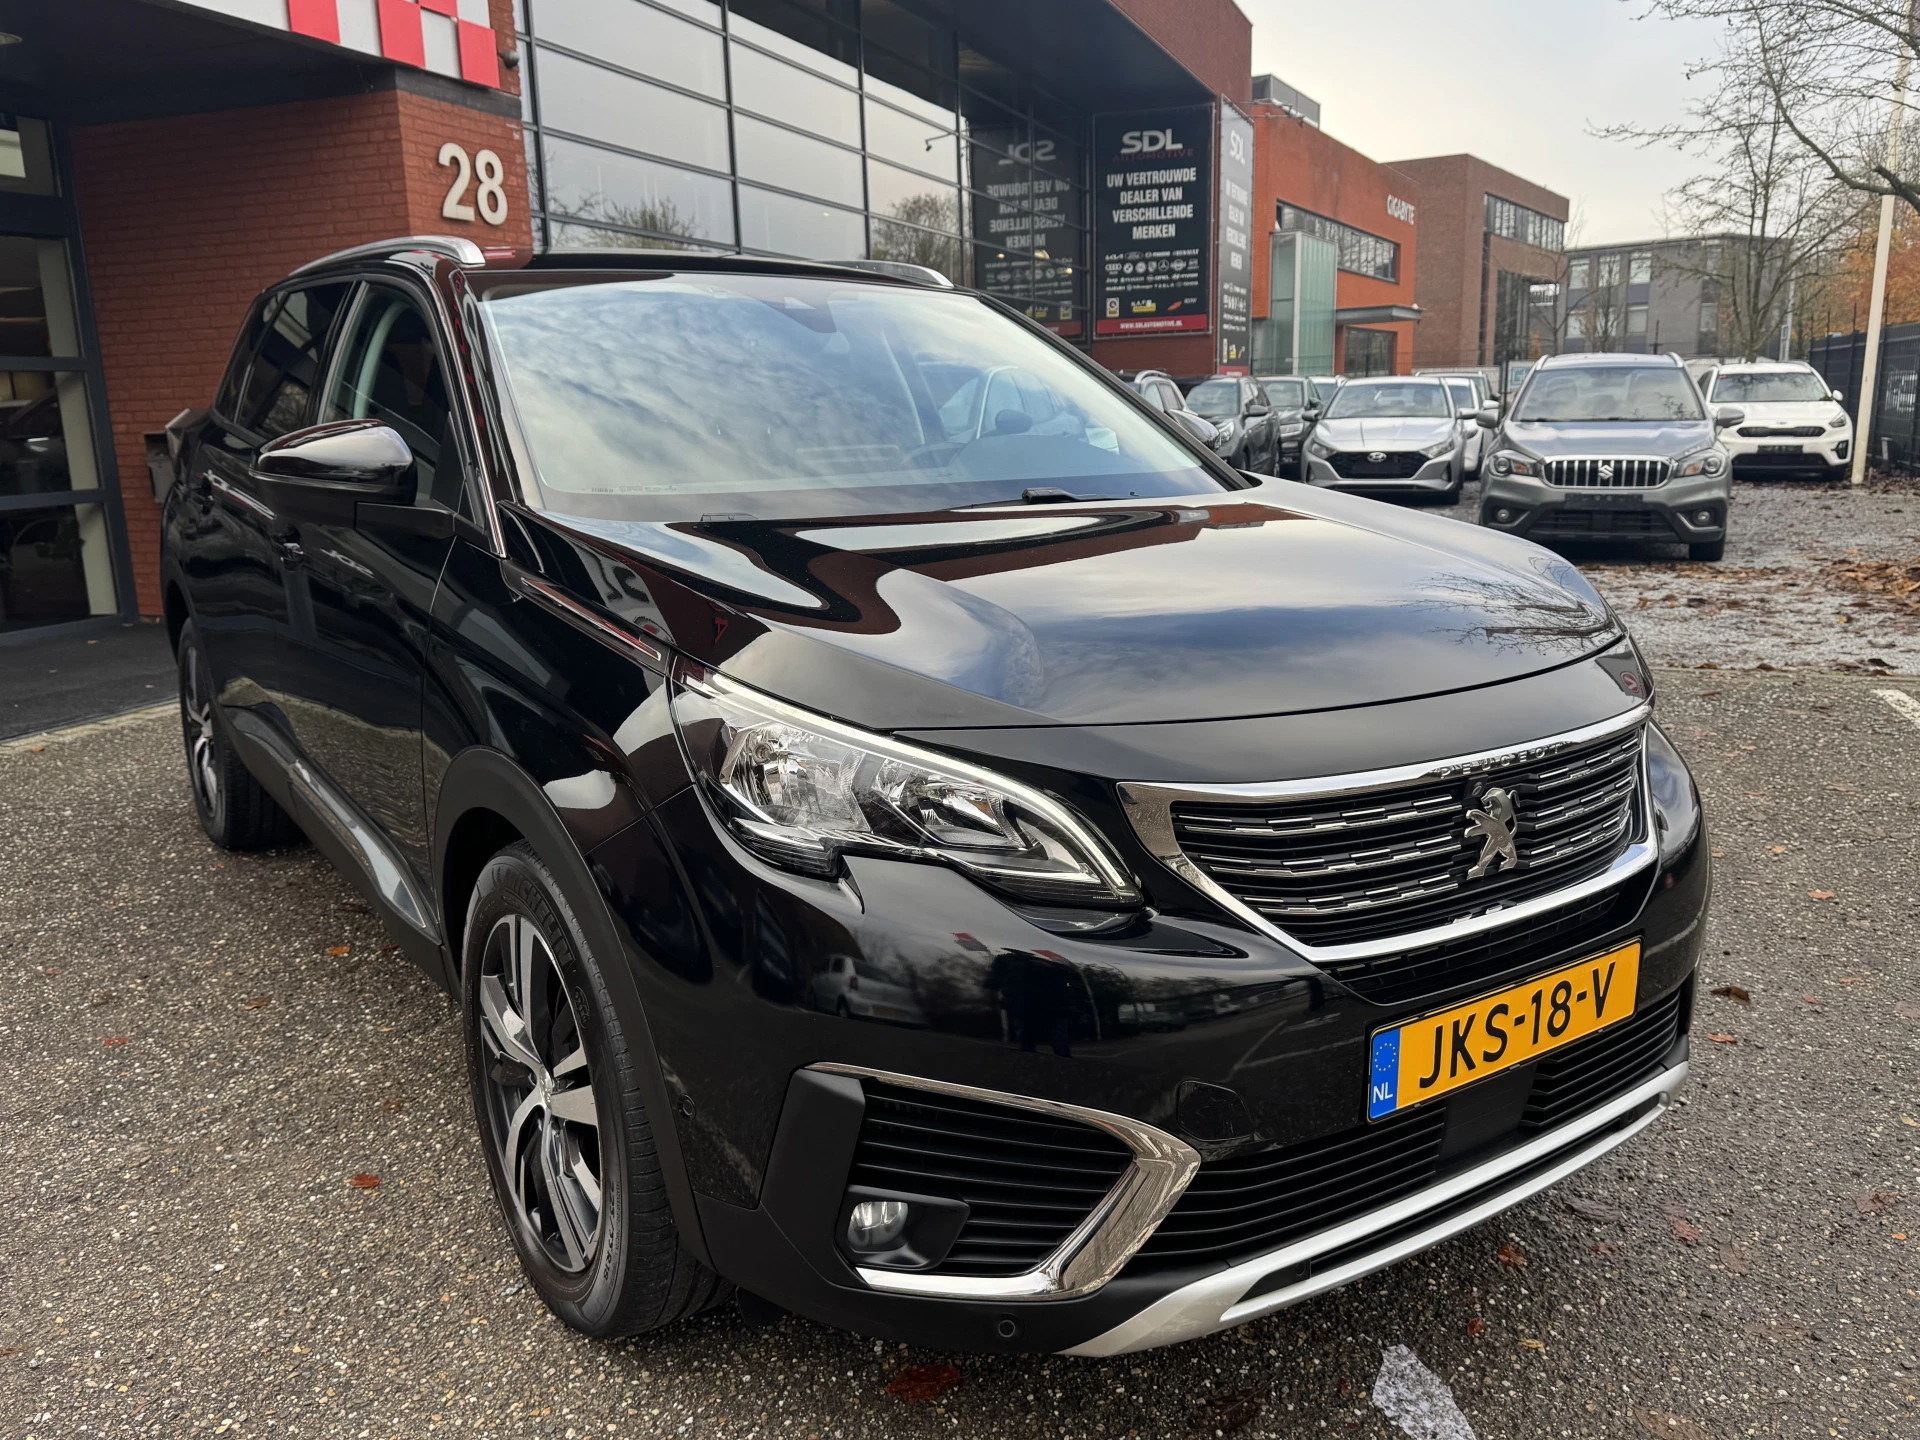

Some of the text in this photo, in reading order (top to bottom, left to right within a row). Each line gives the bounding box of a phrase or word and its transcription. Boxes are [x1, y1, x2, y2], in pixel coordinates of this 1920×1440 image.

[1120, 129, 1183, 154] SDL
[438, 142, 508, 226] 28
[1107, 167, 1197, 188] UW VERTROUWDE
[1120, 187, 1183, 205] DEALER VAN
[1112, 204, 1194, 223] VERSCHILLENDE
[1132, 224, 1175, 240] MERKEN
[1419, 961, 1616, 1089] JKS-18-V
[1372, 1081, 1393, 1104] NL
